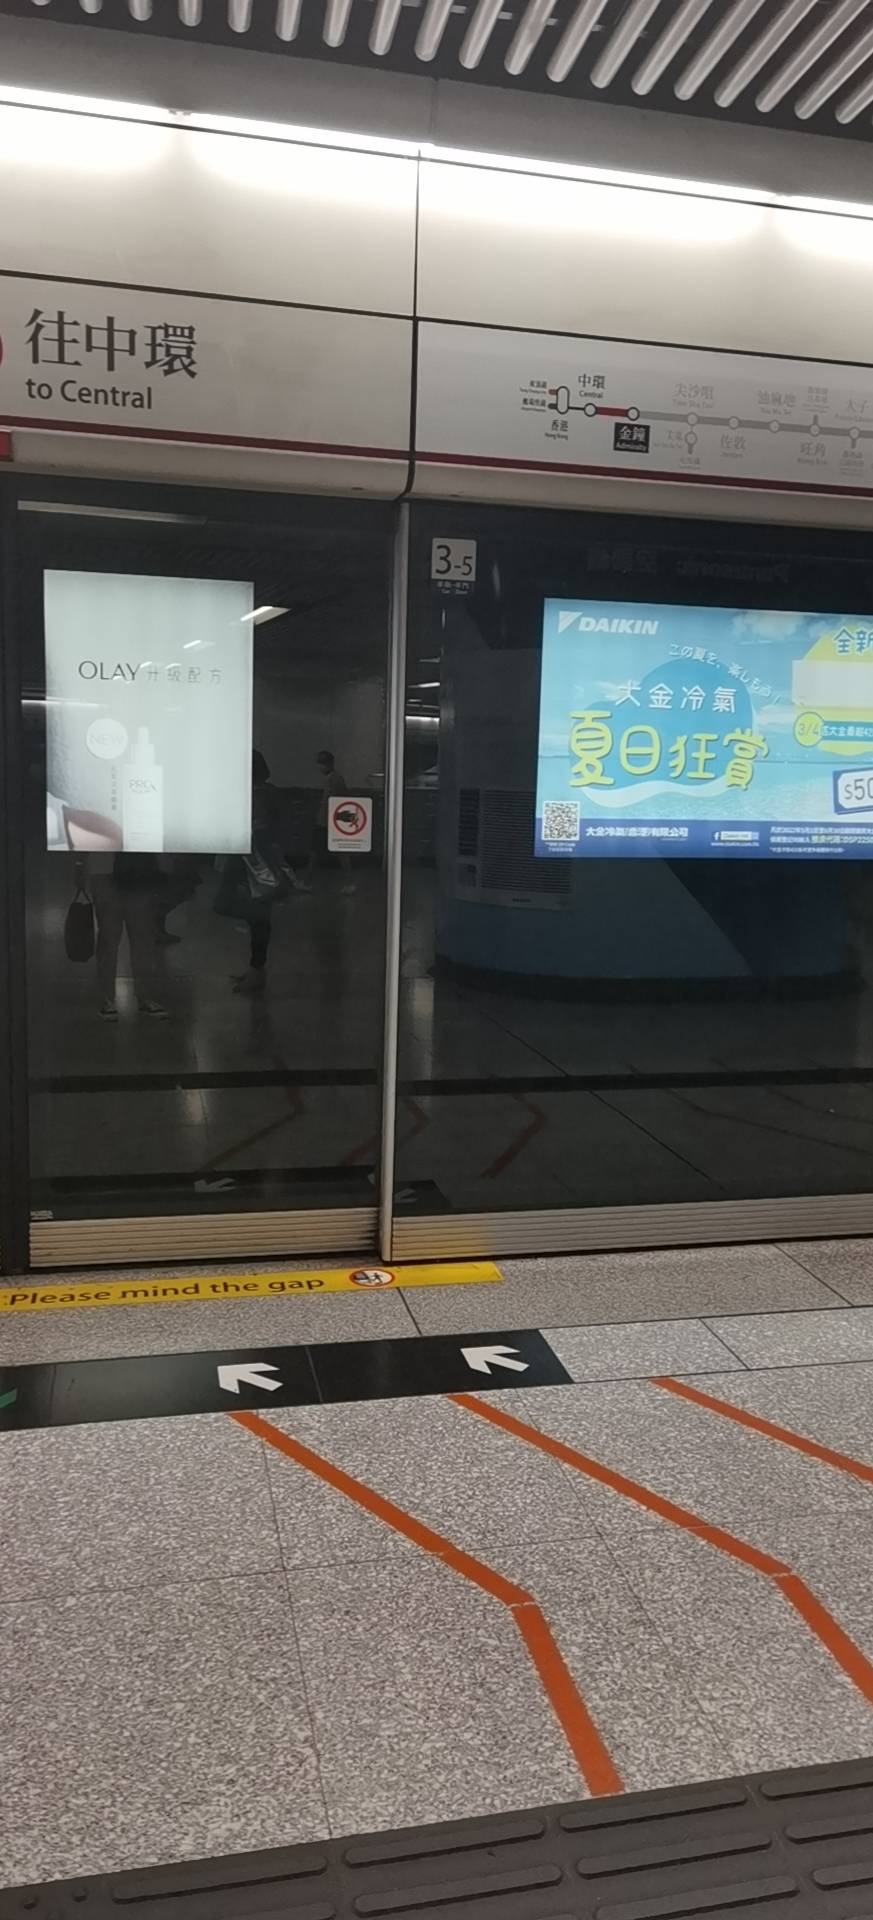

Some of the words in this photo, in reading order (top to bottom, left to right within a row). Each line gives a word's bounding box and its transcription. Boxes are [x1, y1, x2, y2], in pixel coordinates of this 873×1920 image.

[24, 308, 198, 379] 往中環
[25, 378, 53, 400] to
[60, 380, 153, 409] Central
[578, 373, 606, 389] 中環
[579, 390, 604, 398] Central
[435, 544, 473, 576] 3-5
[578, 616, 659, 635] DAIKIN
[78, 660, 142, 682] OLAY
[614, 680, 738, 714] 大金冷氣
[89, 734, 125, 745] NEW
[568, 710, 769, 791] 夏日狂賞
[8, 1288, 111, 1306] Please
[122, 1283, 200, 1299] mind
[210, 1280, 259, 1294] the
[268, 1276, 325, 1293] gap
